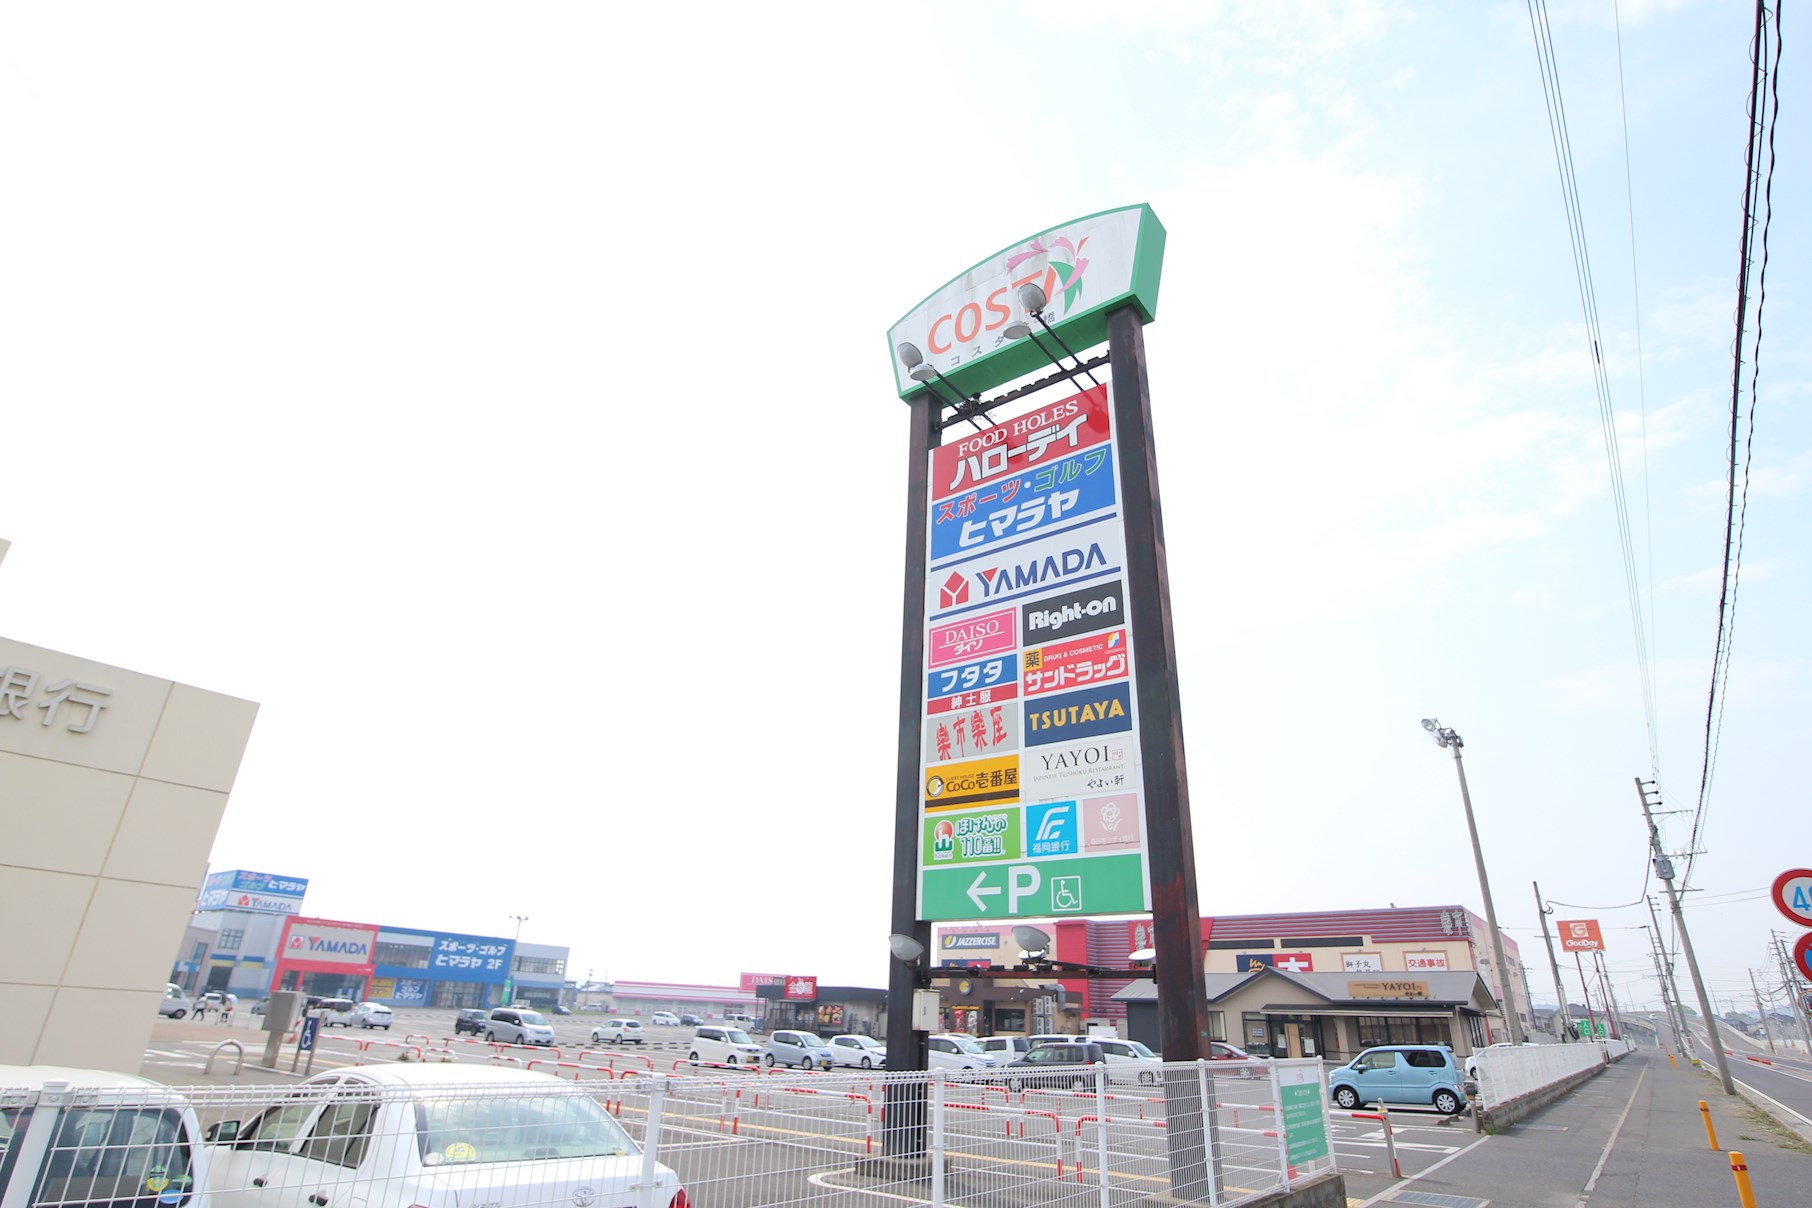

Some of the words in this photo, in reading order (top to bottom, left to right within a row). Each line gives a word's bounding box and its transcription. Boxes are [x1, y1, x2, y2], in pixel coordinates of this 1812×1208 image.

[958, 429, 1008, 457] FOOD
[1013, 400, 1079, 437] HOLES
[949, 413, 1087, 491] ハローデイ
[958, 489, 1080, 547] ヒマラヤ
[975, 543, 1107, 597] YAMADA
[1028, 596, 1117, 630] Right-on
[945, 620, 999, 644] DAISO
[1025, 651, 1040, 668] 薬
[1043, 652, 1062, 662] DRUG
[1069, 643, 1104, 657] COSMETIC
[941, 660, 1003, 692] フタタ
[1025, 653, 1125, 692] サンドラッグ
[951, 689, 991, 709] 紳士服
[1030, 699, 1125, 731] TSUTAYA
[1041, 745, 1109, 770] YAYOI
[956, 816, 1007, 837] ほけんの
[1032, 840, 1070, 853] 福岡銀行
[268, 880, 306, 891] ヒマラヤ
[1008, 865, 1041, 913] P
[252, 898, 292, 911] YAMADA
[1793, 886, 1812, 911] 4
[308, 936, 367, 955] YAMADA
[956, 936, 997, 947] JAZZERCISE
[436, 954, 482, 968] ヒマラヤ
[486, 959, 503, 970] 2F
[1408, 958, 1445, 968] 交通事故
[1382, 983, 1416, 991] YAYOI
